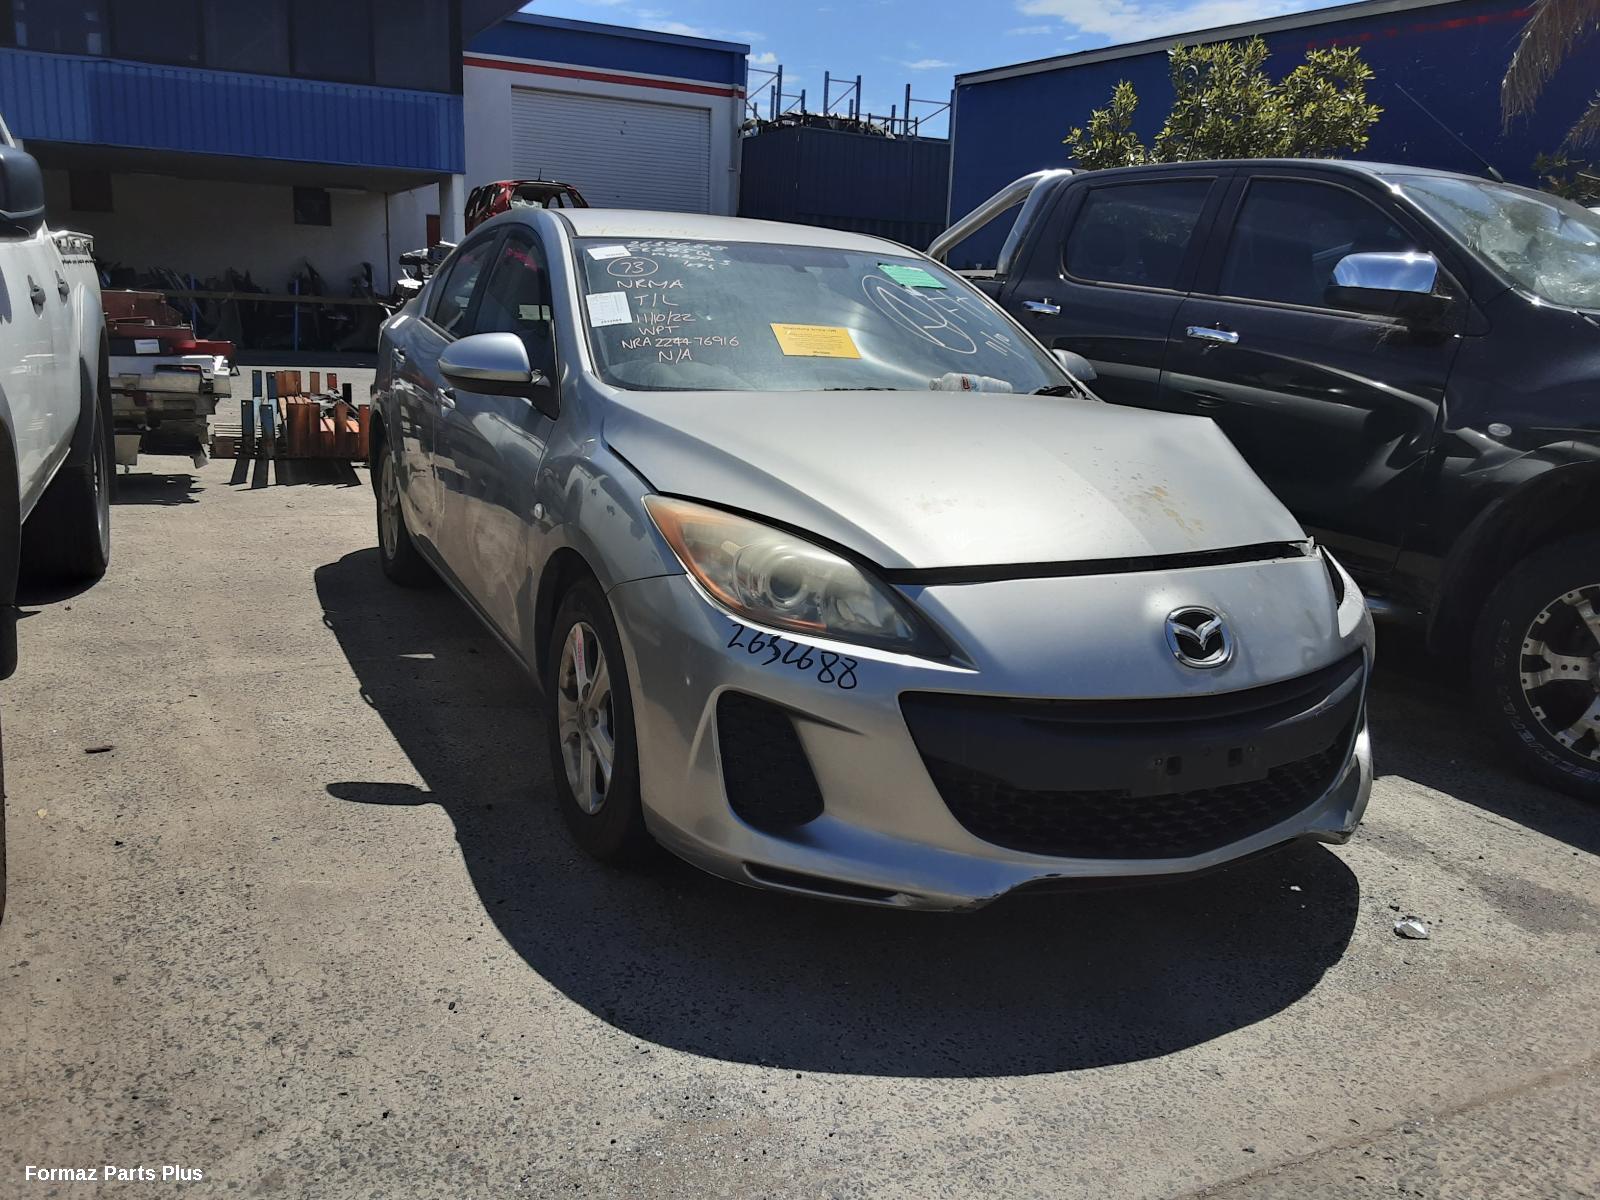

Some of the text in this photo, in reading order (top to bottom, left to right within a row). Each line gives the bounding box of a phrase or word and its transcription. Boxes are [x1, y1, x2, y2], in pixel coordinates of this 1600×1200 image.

[621, 261, 644, 274] 73
[617, 279, 684, 289] NRMA
[634, 293, 679, 307] T/L
[635, 311, 697, 325] 11/10/22
[638, 325, 680, 335] WPT
[658, 349, 693, 364] N/A
